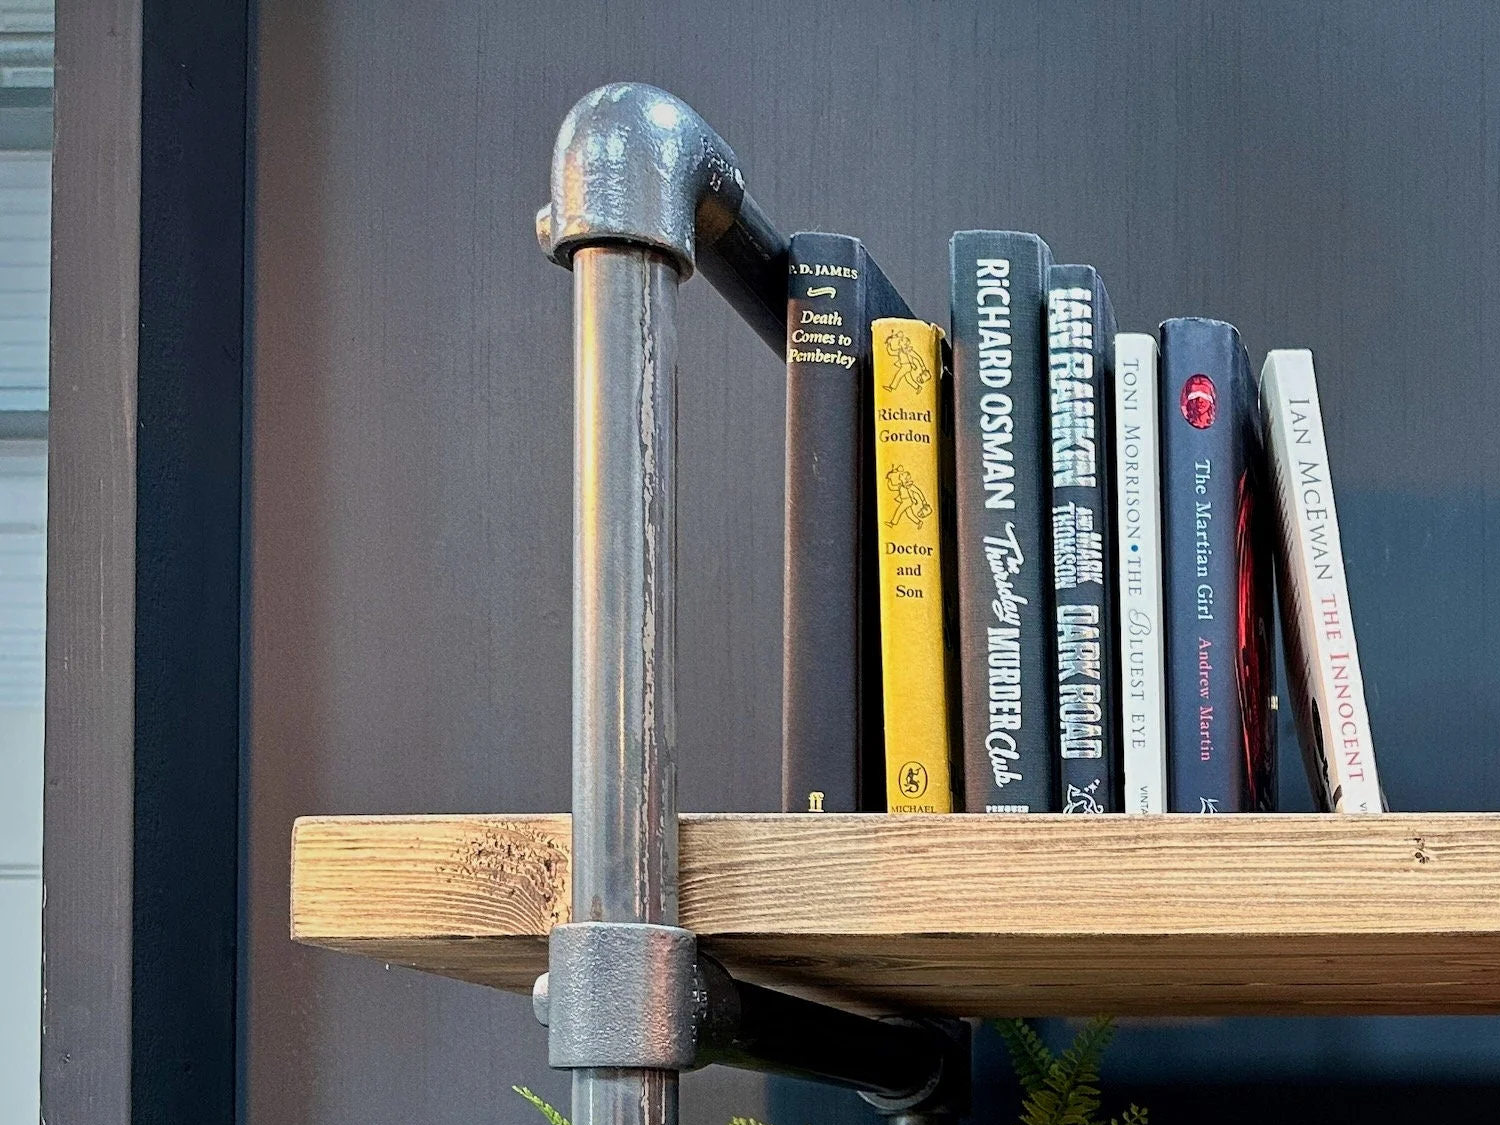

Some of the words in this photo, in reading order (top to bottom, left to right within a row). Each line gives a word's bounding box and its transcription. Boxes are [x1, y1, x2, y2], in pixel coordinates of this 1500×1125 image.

[799, 264, 813, 275] D.
[814, 264, 859, 280] JAMES
[791, 329, 836, 345] Comes
[837, 334, 853, 347] to
[800, 310, 843, 327] Death
[1048, 287, 1092, 350] IAN
[786, 347, 857, 370] Pemberley
[1122, 358, 1140, 411] TONI
[877, 408, 932, 423] Richard
[878, 429, 931, 444] Gordon
[1050, 352, 1097, 488] RANKIN
[1288, 397, 1312, 445] IAN
[978, 393, 1016, 510] OSMAN
[1123, 425, 1142, 539] MORRISON
[1194, 459, 1211, 495] The
[1075, 506, 1094, 531] AND
[1195, 503, 1213, 578] Martian
[885, 542, 934, 557] Doctor
[1052, 501, 1078, 590] THOMSON
[1075, 531, 1104, 585] MARK
[895, 585, 924, 599] Son
[896, 564, 922, 577] and
[983, 521, 1028, 627] Thursday
[1128, 556, 1142, 596] THE
[1196, 584, 1214, 621] Girl
[1320, 593, 1342, 640] THE
[1056, 604, 1101, 681] DARK
[1128, 608, 1151, 701] BLUEST
[987, 626, 1023, 731] MURDER
[1198, 636, 1213, 700] Andrew
[1058, 683, 1103, 759] ROAD
[1131, 712, 1146, 750] EYE
[1199, 705, 1215, 762] Martin
[1329, 651, 1365, 784] INNOCENT
[984, 730, 1023, 788] Club
[891, 805, 937, 814] MICHAEL
[1140, 785, 1149, 815] VINTA
